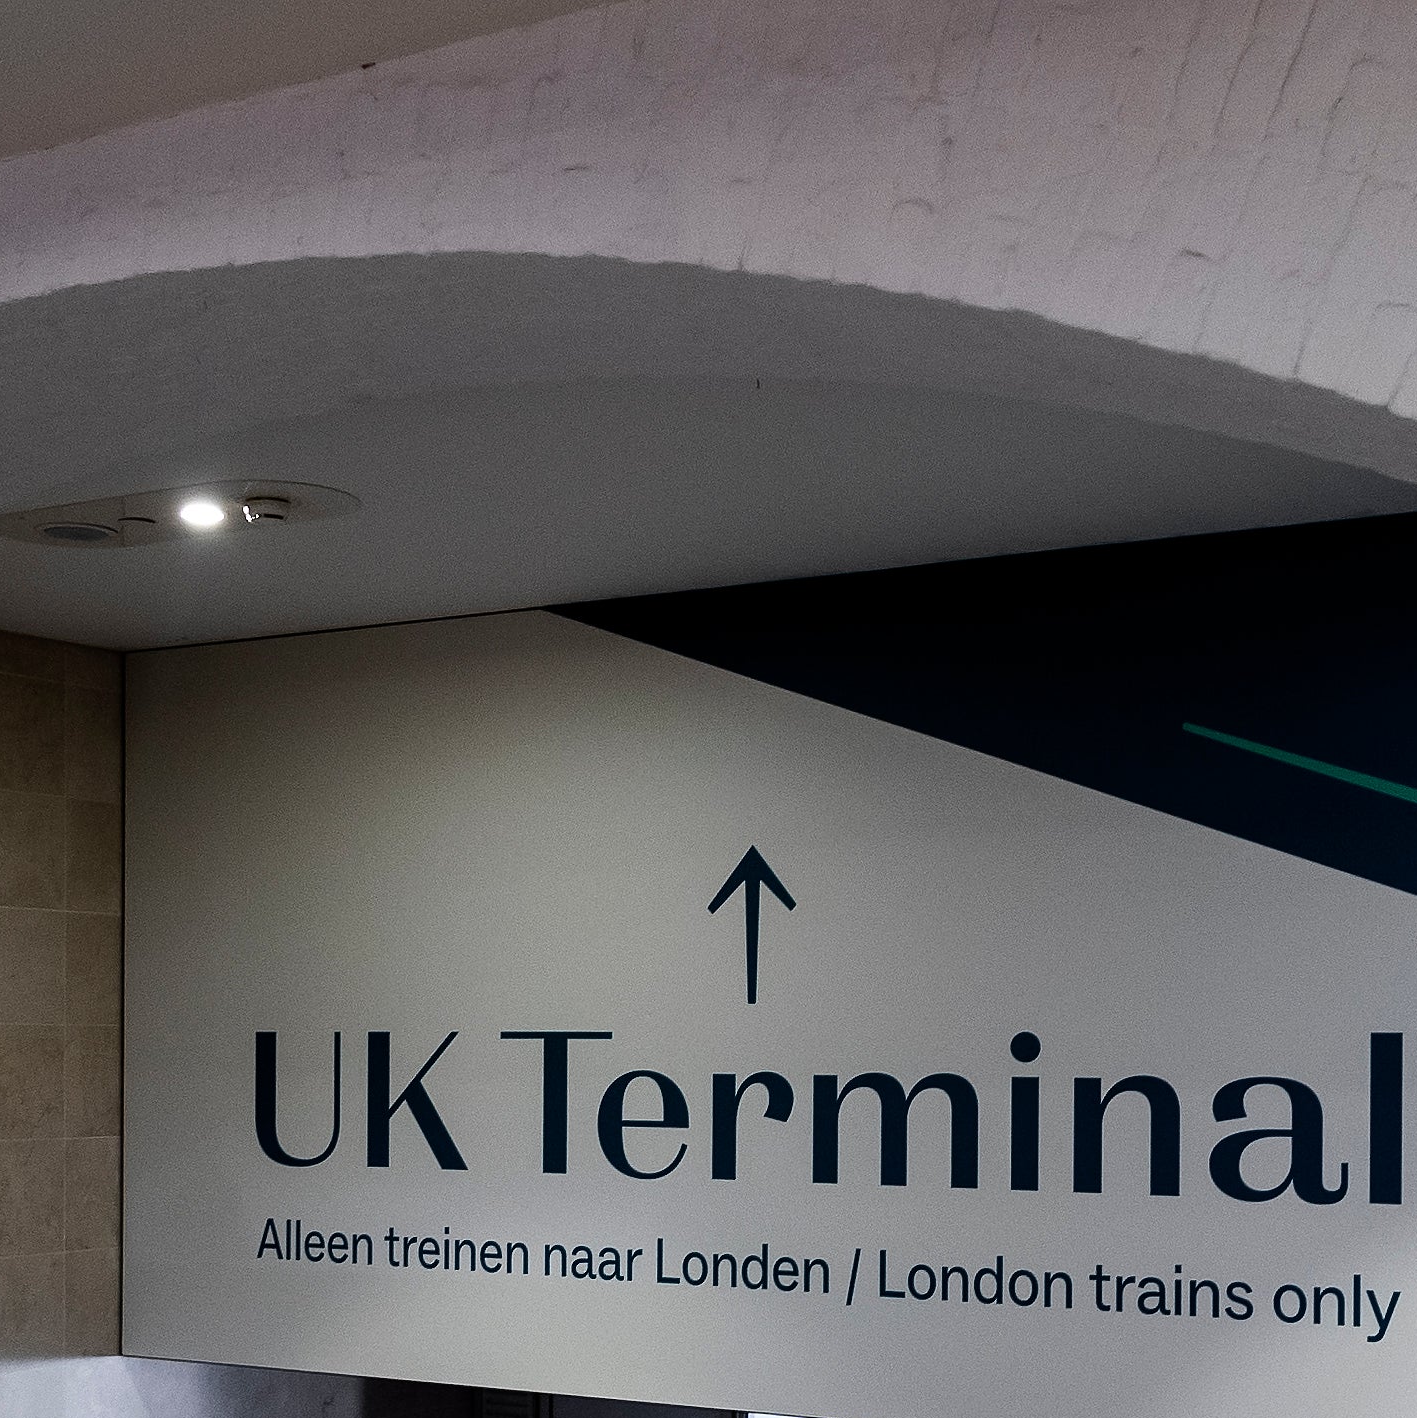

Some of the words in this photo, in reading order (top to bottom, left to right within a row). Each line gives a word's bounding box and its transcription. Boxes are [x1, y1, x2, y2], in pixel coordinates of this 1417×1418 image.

[254, 1031, 469, 1171] UK
[500, 1031, 1404, 1206] Terminal
[256, 1217, 373, 1266] Alleen
[383, 1227, 529, 1275] treinen
[544, 1244, 643, 1282] naar
[656, 1237, 830, 1294] Londen
[845, 1248, 862, 1306] /
[879, 1249, 1073, 1309] London
[1088, 1264, 1254, 1321] trains
[1273, 1274, 1401, 1343] only
